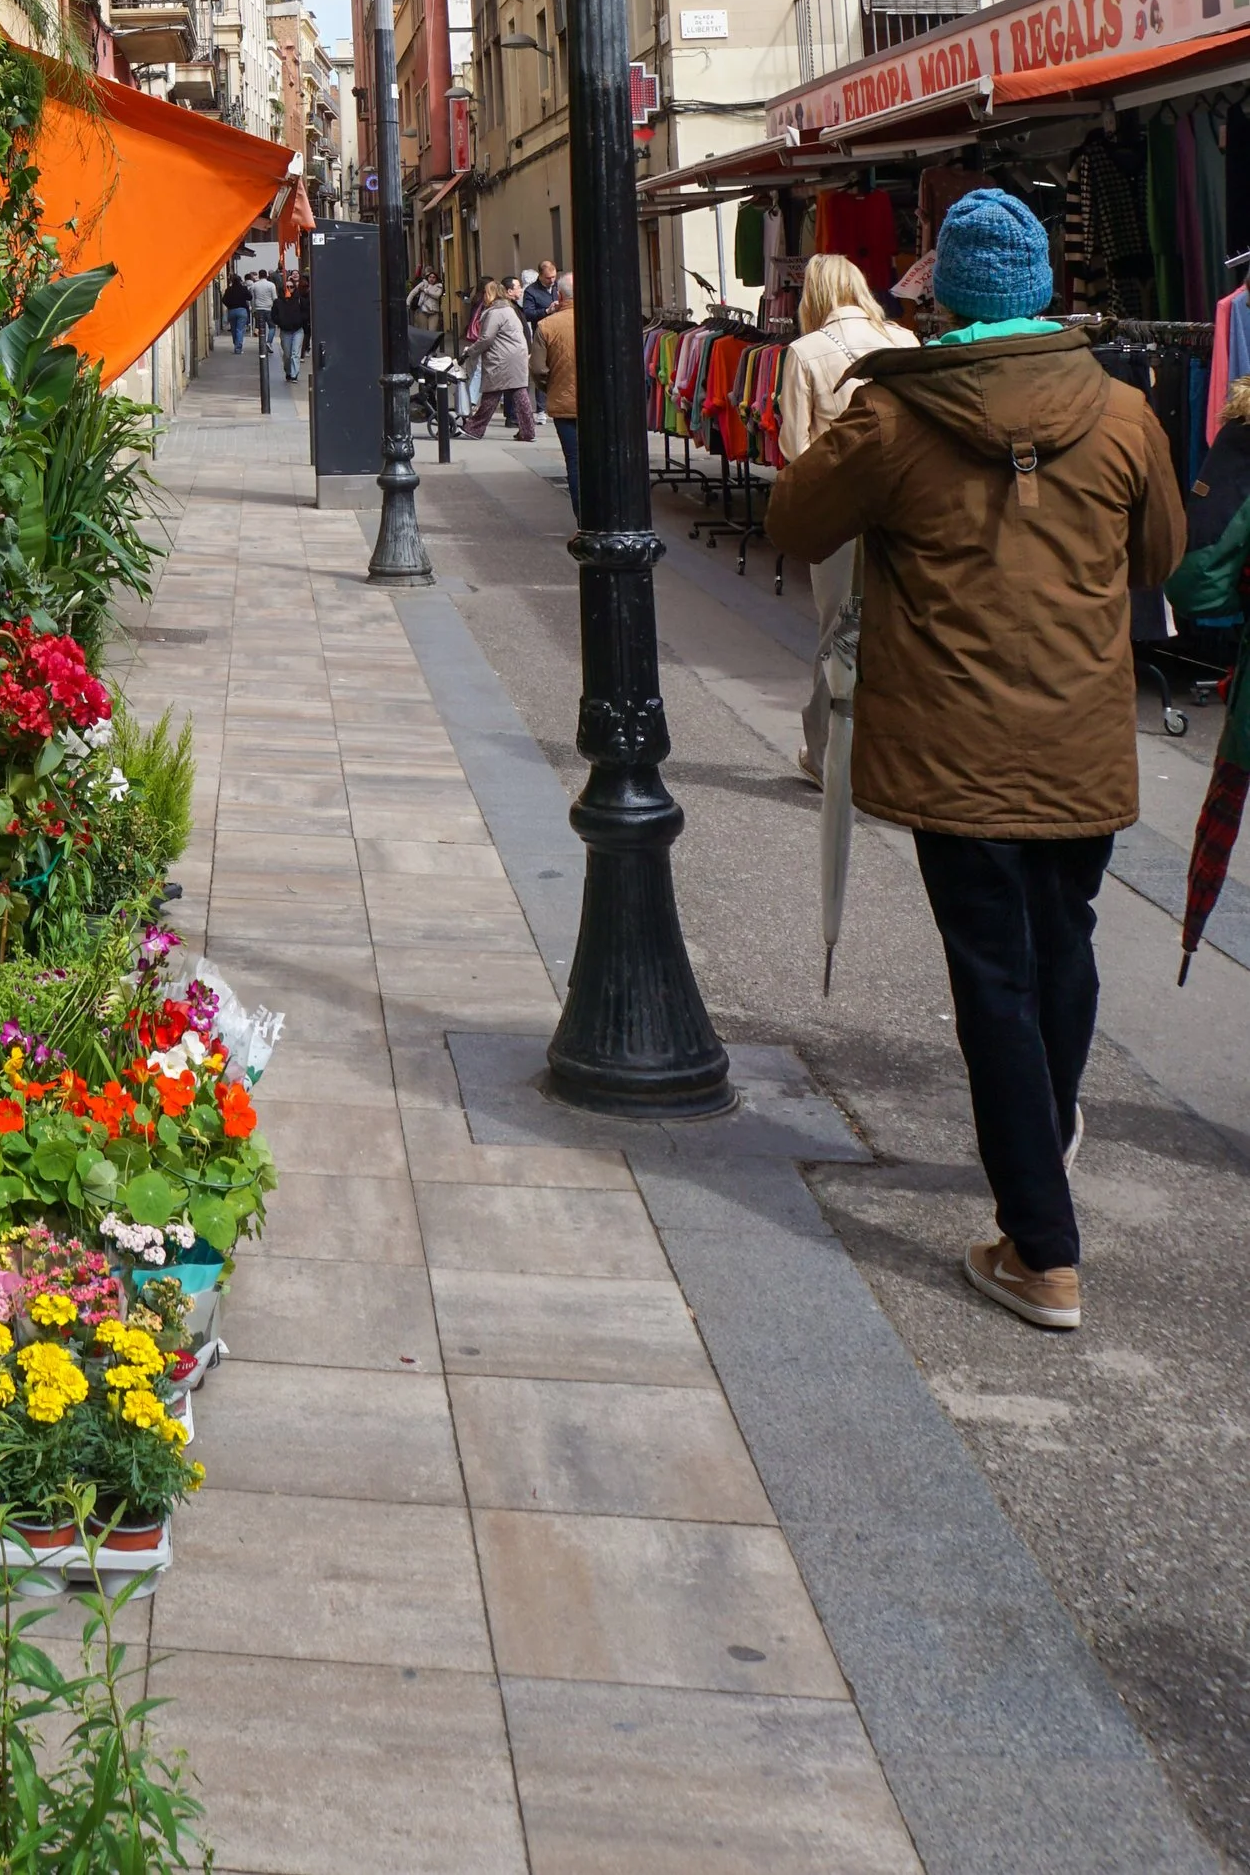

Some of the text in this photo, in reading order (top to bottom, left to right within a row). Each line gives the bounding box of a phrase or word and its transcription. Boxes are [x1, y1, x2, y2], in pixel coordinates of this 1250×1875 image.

[686, 25, 722, 33] LLIBERTAT
[842, 63, 913, 122] EUROPA
[919, 37, 982, 102] MODA
[990, 28, 1003, 76] I
